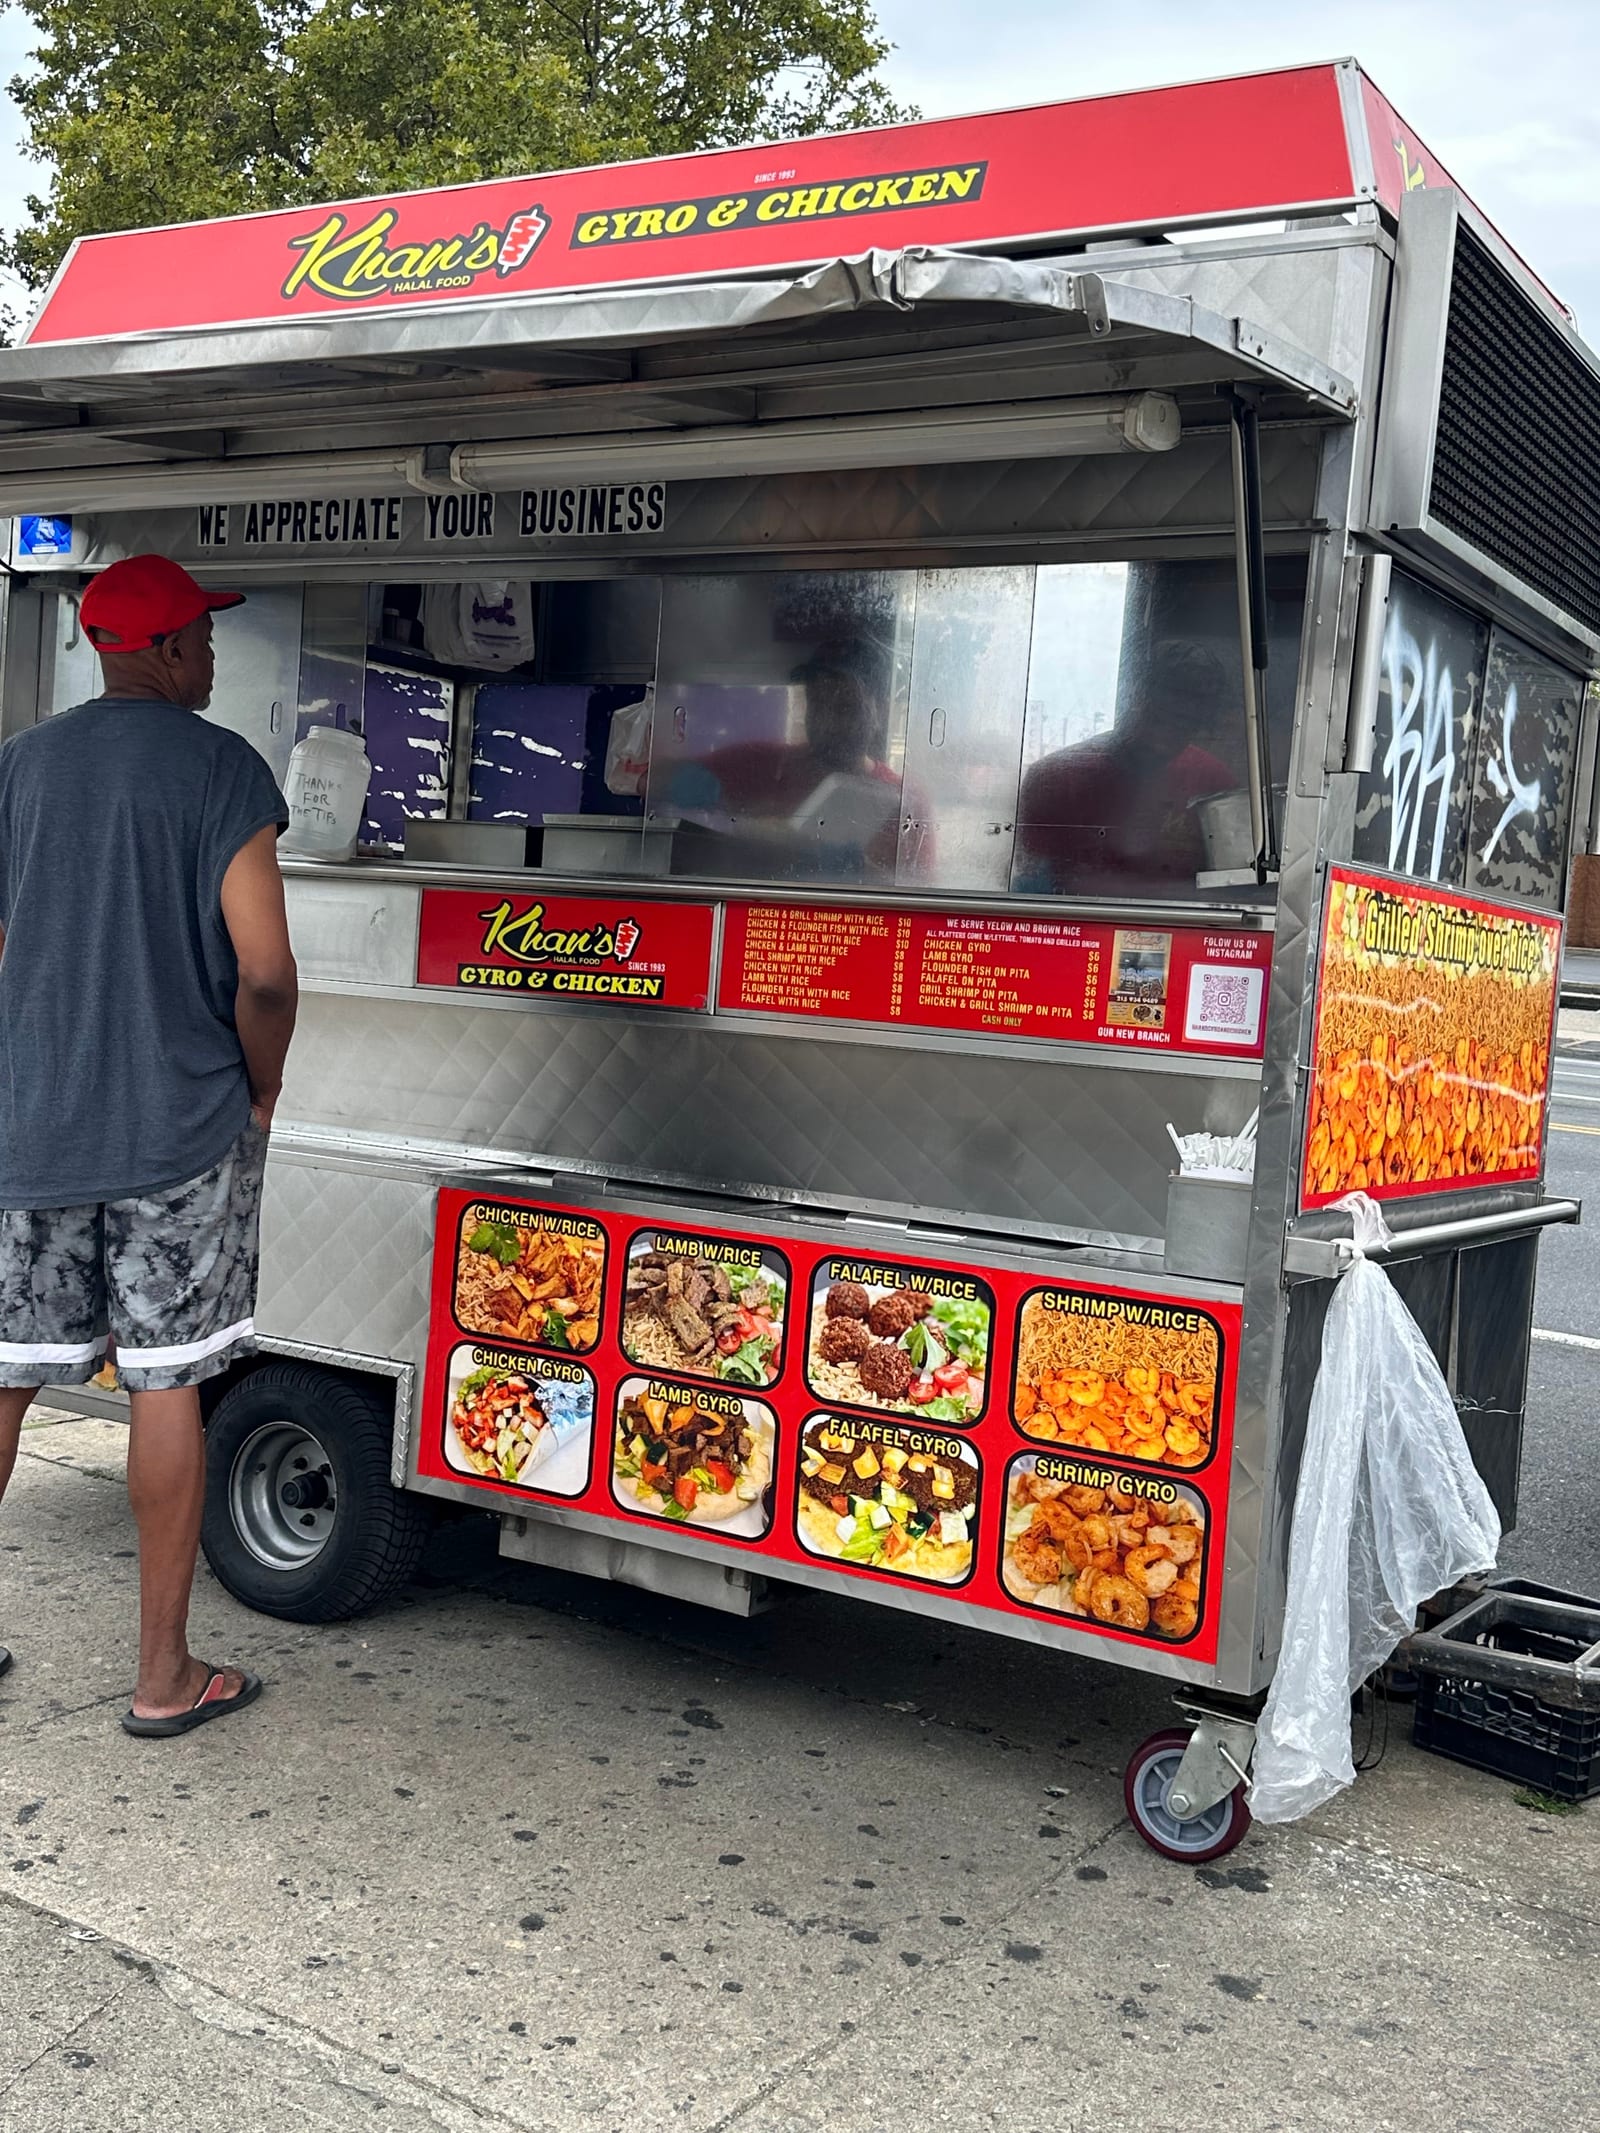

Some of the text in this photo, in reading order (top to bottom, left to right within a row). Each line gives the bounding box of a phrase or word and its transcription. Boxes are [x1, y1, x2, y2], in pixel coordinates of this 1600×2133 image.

[754, 172, 777, 183] SINCE
[577, 168, 981, 244] GYRO & CHICKEN
[285, 211, 499, 297] Khan's
[394, 275, 471, 292] HALAL FOOD
[200, 485, 663, 545] WE APPRECIATE YOUR BUSINESS
[303, 792, 330, 806] FOR
[747, 918, 778, 929] CHICKEN
[789, 921, 828, 932] FLOUNDER
[830, 924, 847, 933] FISH
[849, 926, 869, 935] WITH
[871, 927, 889, 936] RICE
[897, 929, 910, 938] $10
[749, 908, 779, 918] CHICKEN
[790, 910, 811, 920] GRILL
[814, 912, 842, 922] SHRIMP
[844, 914, 864, 924] WITH
[866, 916, 884, 925] RICE
[898, 918, 911, 927] $10
[947, 919, 1080, 935] WE SERVE YELOW AND BROWN RICE
[481, 902, 613, 961] Khan's
[746, 929, 777, 940] CHICKEN
[787, 932, 819, 942] FALAFEL
[822, 936, 841, 944] WITH
[844, 937, 861, 946] RICE
[896, 940, 909, 949] $10
[939, 930, 966, 939] PLATTERS
[1365, 899, 1536, 973] Grilled Shrimp over Rice
[745, 940, 776, 950] CHICKEN
[787, 944, 807, 952] LAMB
[809, 945, 829, 954] WITH
[831, 946, 848, 956] RICE
[895, 951, 904, 960] $8
[924, 940, 1100, 961] CHICKEN GYRO $6
[1204, 937, 1257, 949] FOLOW US ON
[744, 951, 903, 971] GRILL SHRIMP WITH RICE $8
[923, 952, 1098, 973] LAMB GYRO $6
[1207, 949, 1252, 959] INSTAGRAM
[628, 962, 665, 972] SINCE 1993
[744, 961, 903, 982] CHICKEN WITH RICE $8
[922, 962, 1097, 985] FLOUNDER FISH ON PITA $6
[460, 967, 661, 995] GYRO & CHICKEN
[743, 972, 902, 993] LAMB WITH RICE $8
[921, 973, 1096, 996] FALAFEL ON PITA $6
[742, 983, 901, 1004] FLOUNDER FISH WITH RICE $8
[946, 987, 980, 998] SHRIMP
[983, 990, 994, 999] ON
[998, 991, 1018, 1001] PITA
[1084, 998, 1095, 1008] $6
[741, 994, 900, 1015] FALAFEL WITH RICE $8
[919, 996, 1094, 1020] CHICKEN & GRILL SHRIMP ON PITA $8
[982, 1015, 1022, 1026] CASH ONLY
[1098, 1027, 1170, 1042] OUR NEW BRANCH
[475, 1205, 598, 1239] CHICKEN W/RICE
[655, 1236, 762, 1266] LAMB W/RICE
[830, 1263, 977, 1300] FALAFEL W/RICE
[1043, 1293, 1200, 1331] SHRIMP W/RICE
[473, 1349, 584, 1383] CHICKEN GYRO
[649, 1382, 743, 1416] LAMB GYRO
[829, 1418, 961, 1458] FALAFEL GYRO
[1036, 1459, 1177, 1502] SHRIMP GYRO
